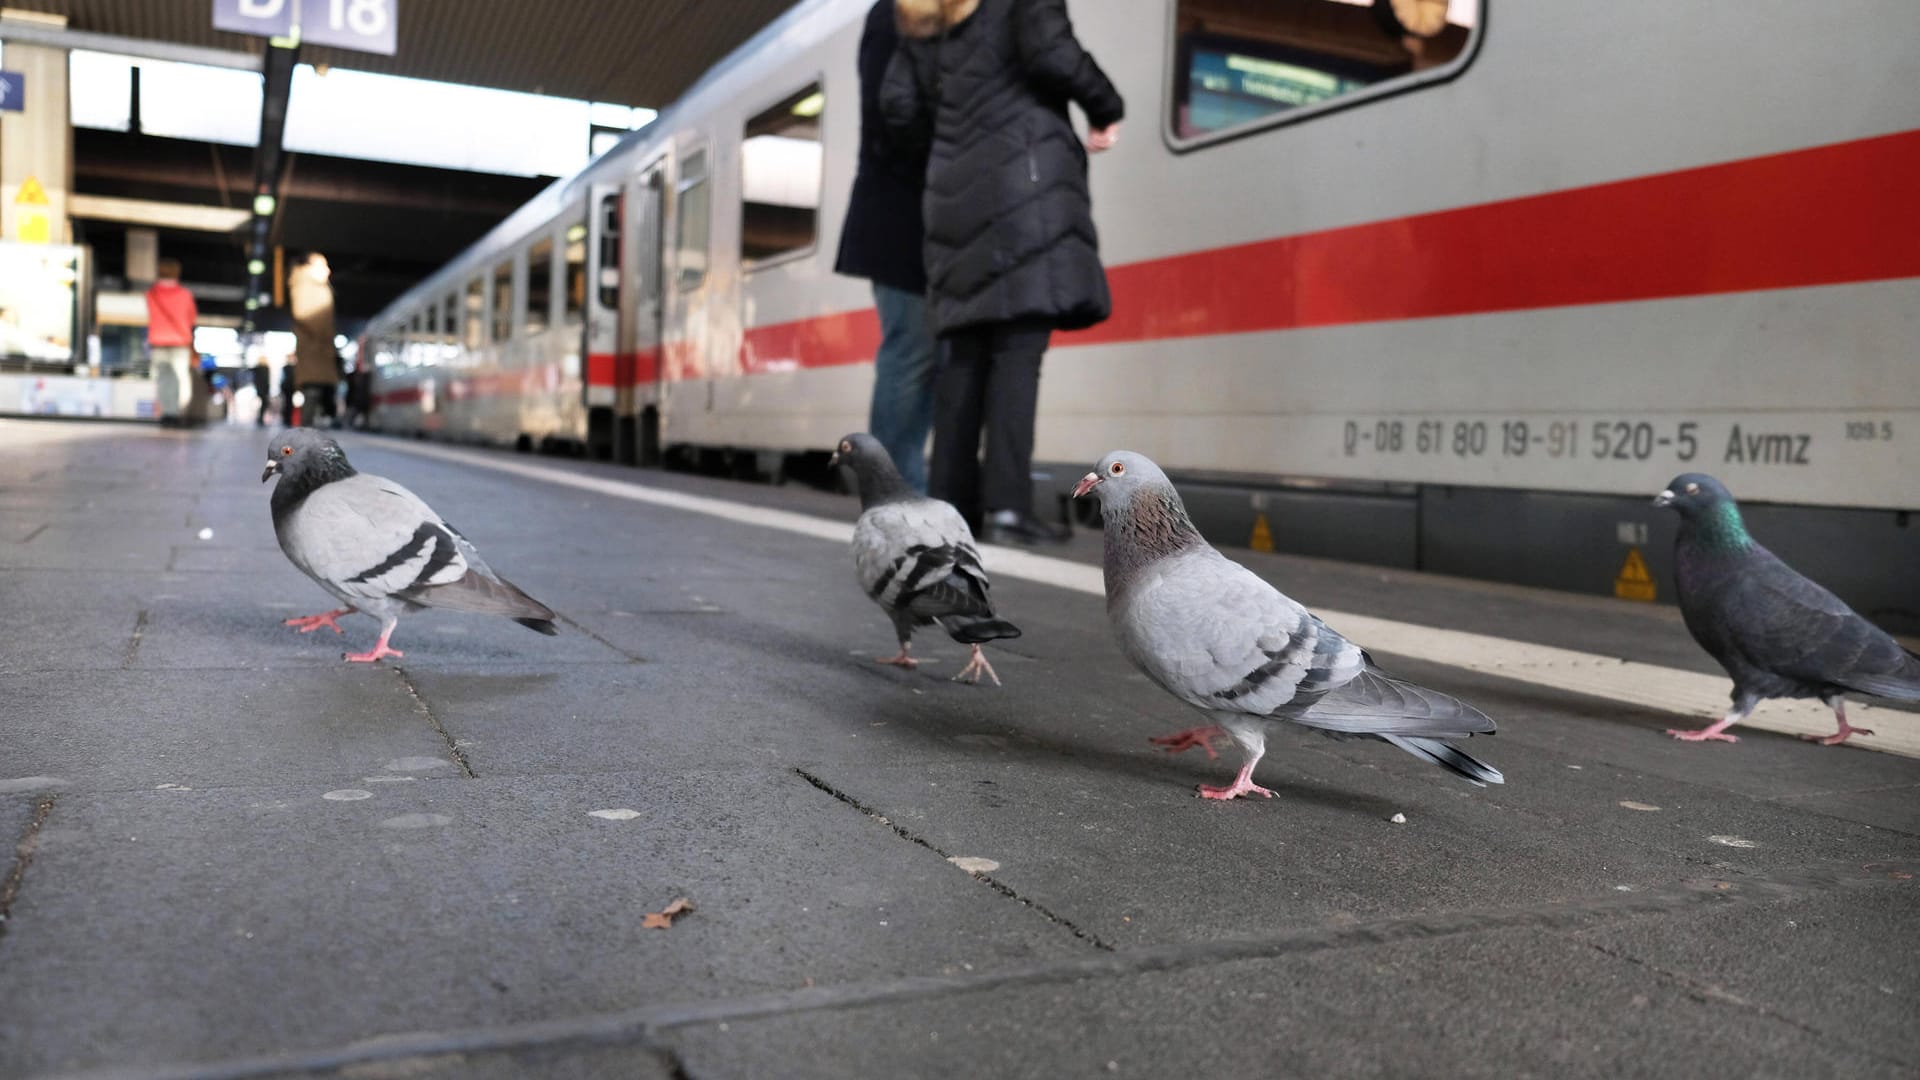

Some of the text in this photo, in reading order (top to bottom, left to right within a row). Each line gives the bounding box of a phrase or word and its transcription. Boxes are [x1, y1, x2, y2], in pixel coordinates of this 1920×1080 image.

[1416, 420, 1443, 454] 61
[1453, 421, 1487, 457] 80
[1502, 421, 1578, 458] 19-91
[1592, 421, 1698, 461] 520-5
[1724, 423, 1811, 464] Avmz
